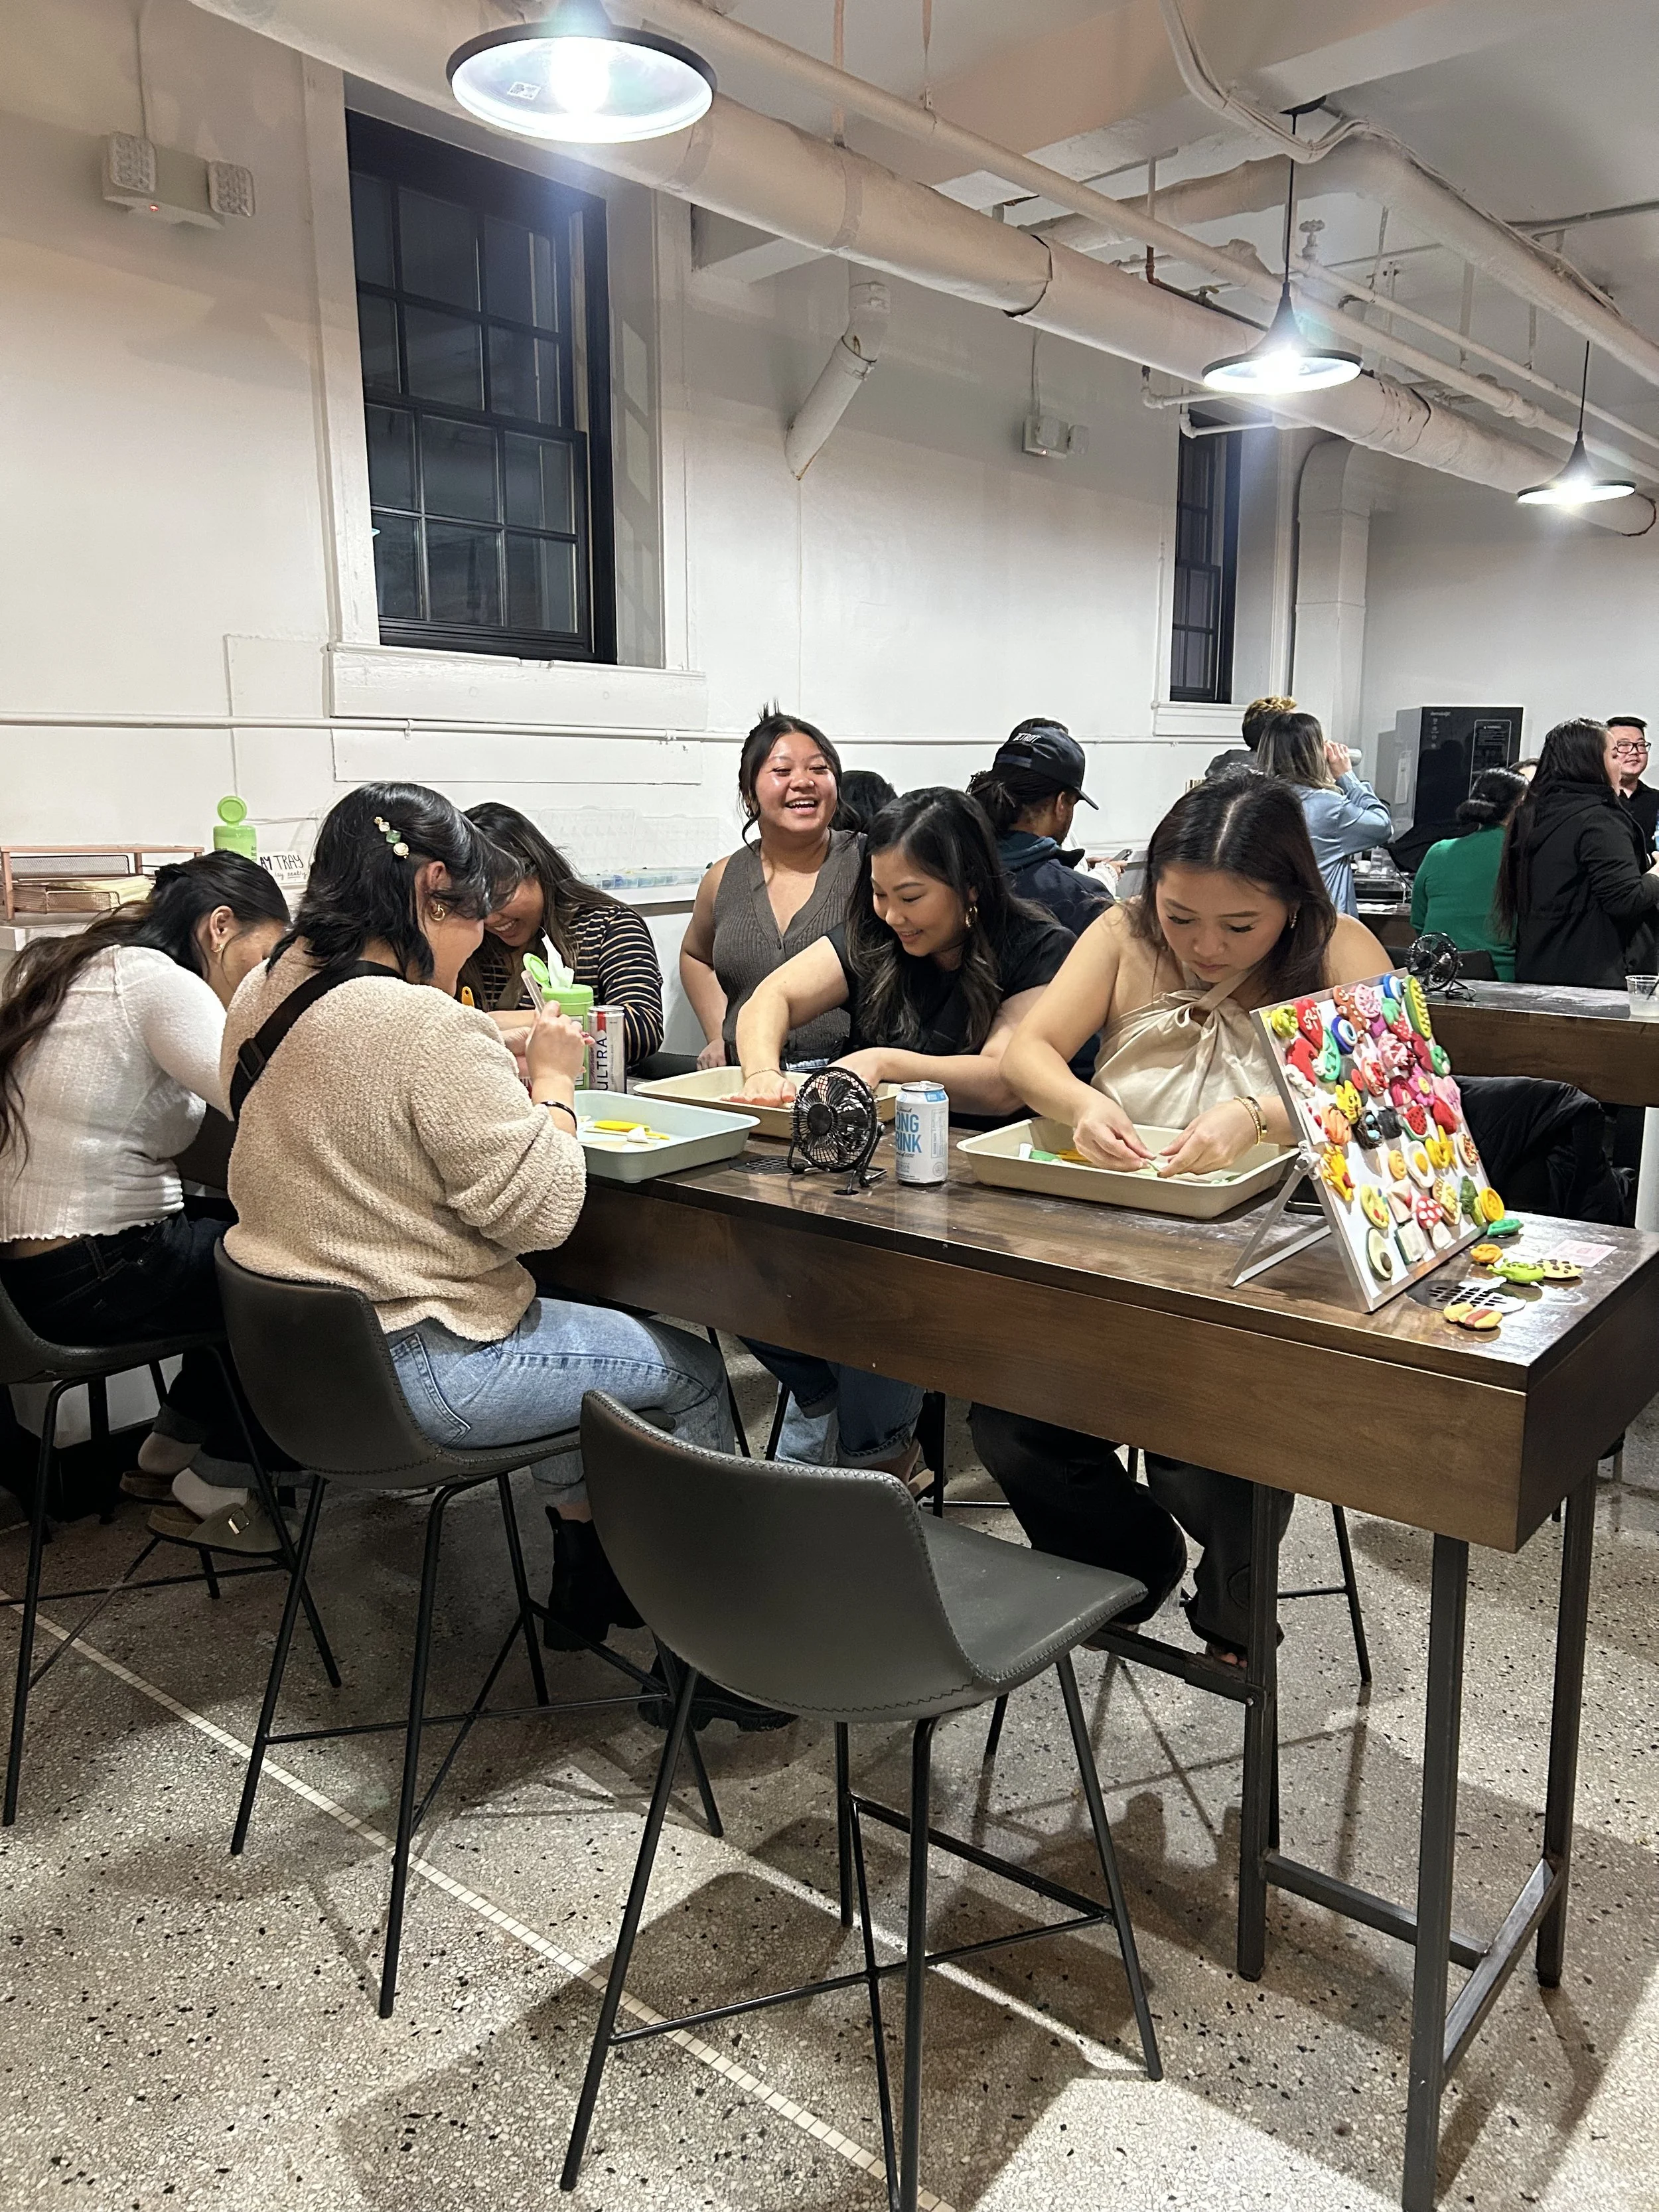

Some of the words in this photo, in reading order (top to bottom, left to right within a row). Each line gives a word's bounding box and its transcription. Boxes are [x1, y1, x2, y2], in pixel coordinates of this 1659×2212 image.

[1013, 733, 1042, 743] DETROIT
[260, 856, 273, 871] AY
[273, 854, 304, 870] TRAY
[596, 1037, 609, 1091] ULTRA
[896, 1111, 920, 1133] ONG
[896, 1130, 922, 1153] RINK
